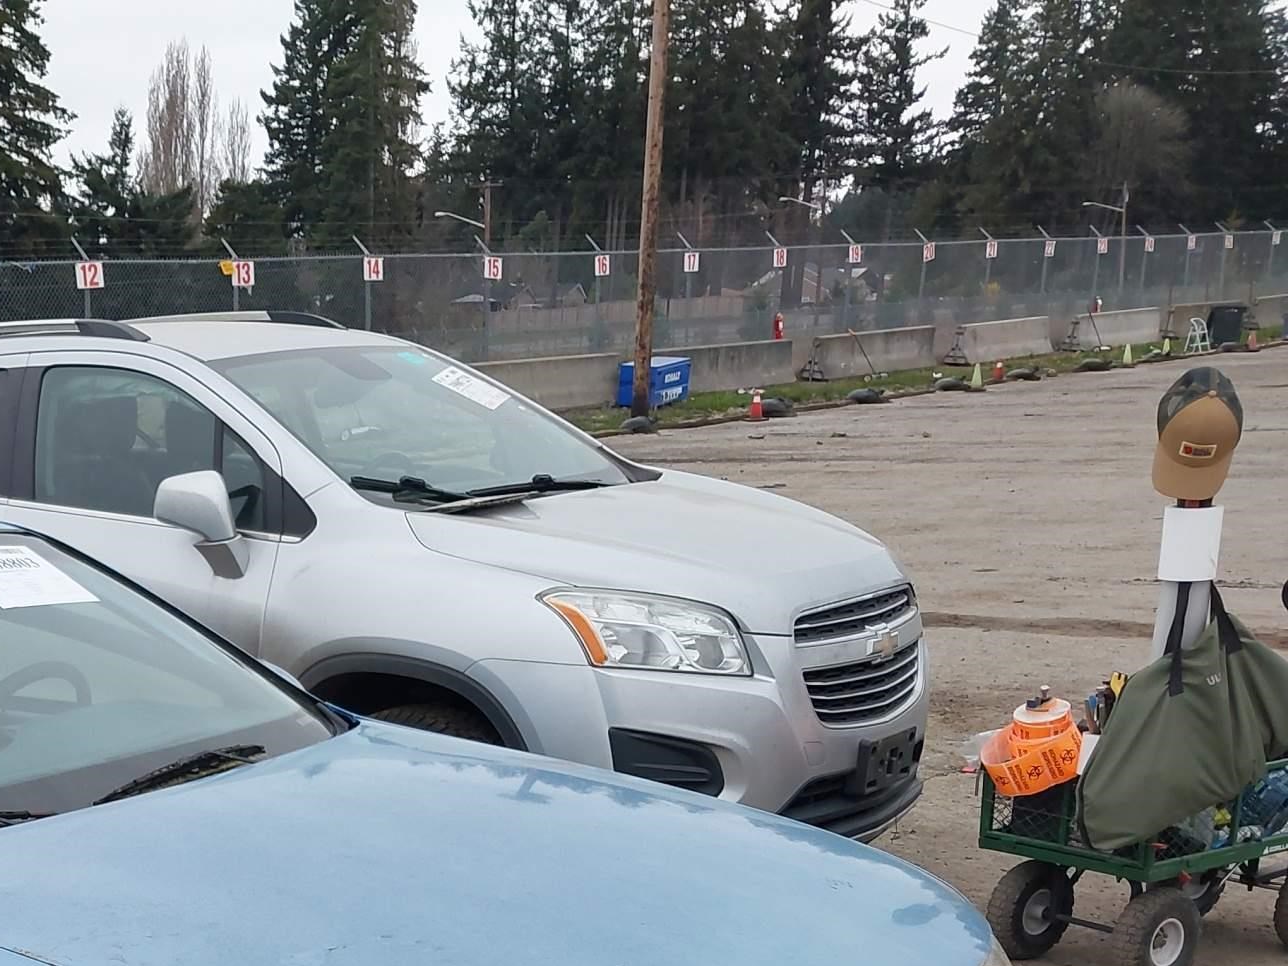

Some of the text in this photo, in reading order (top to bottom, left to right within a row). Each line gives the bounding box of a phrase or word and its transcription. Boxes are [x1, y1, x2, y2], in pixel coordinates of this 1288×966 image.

[235, 262, 251, 284] 13
[367, 259, 380, 279] 14
[487, 258, 499, 277] 15
[597, 256, 607, 274] 16
[80, 264, 99, 287] 12
